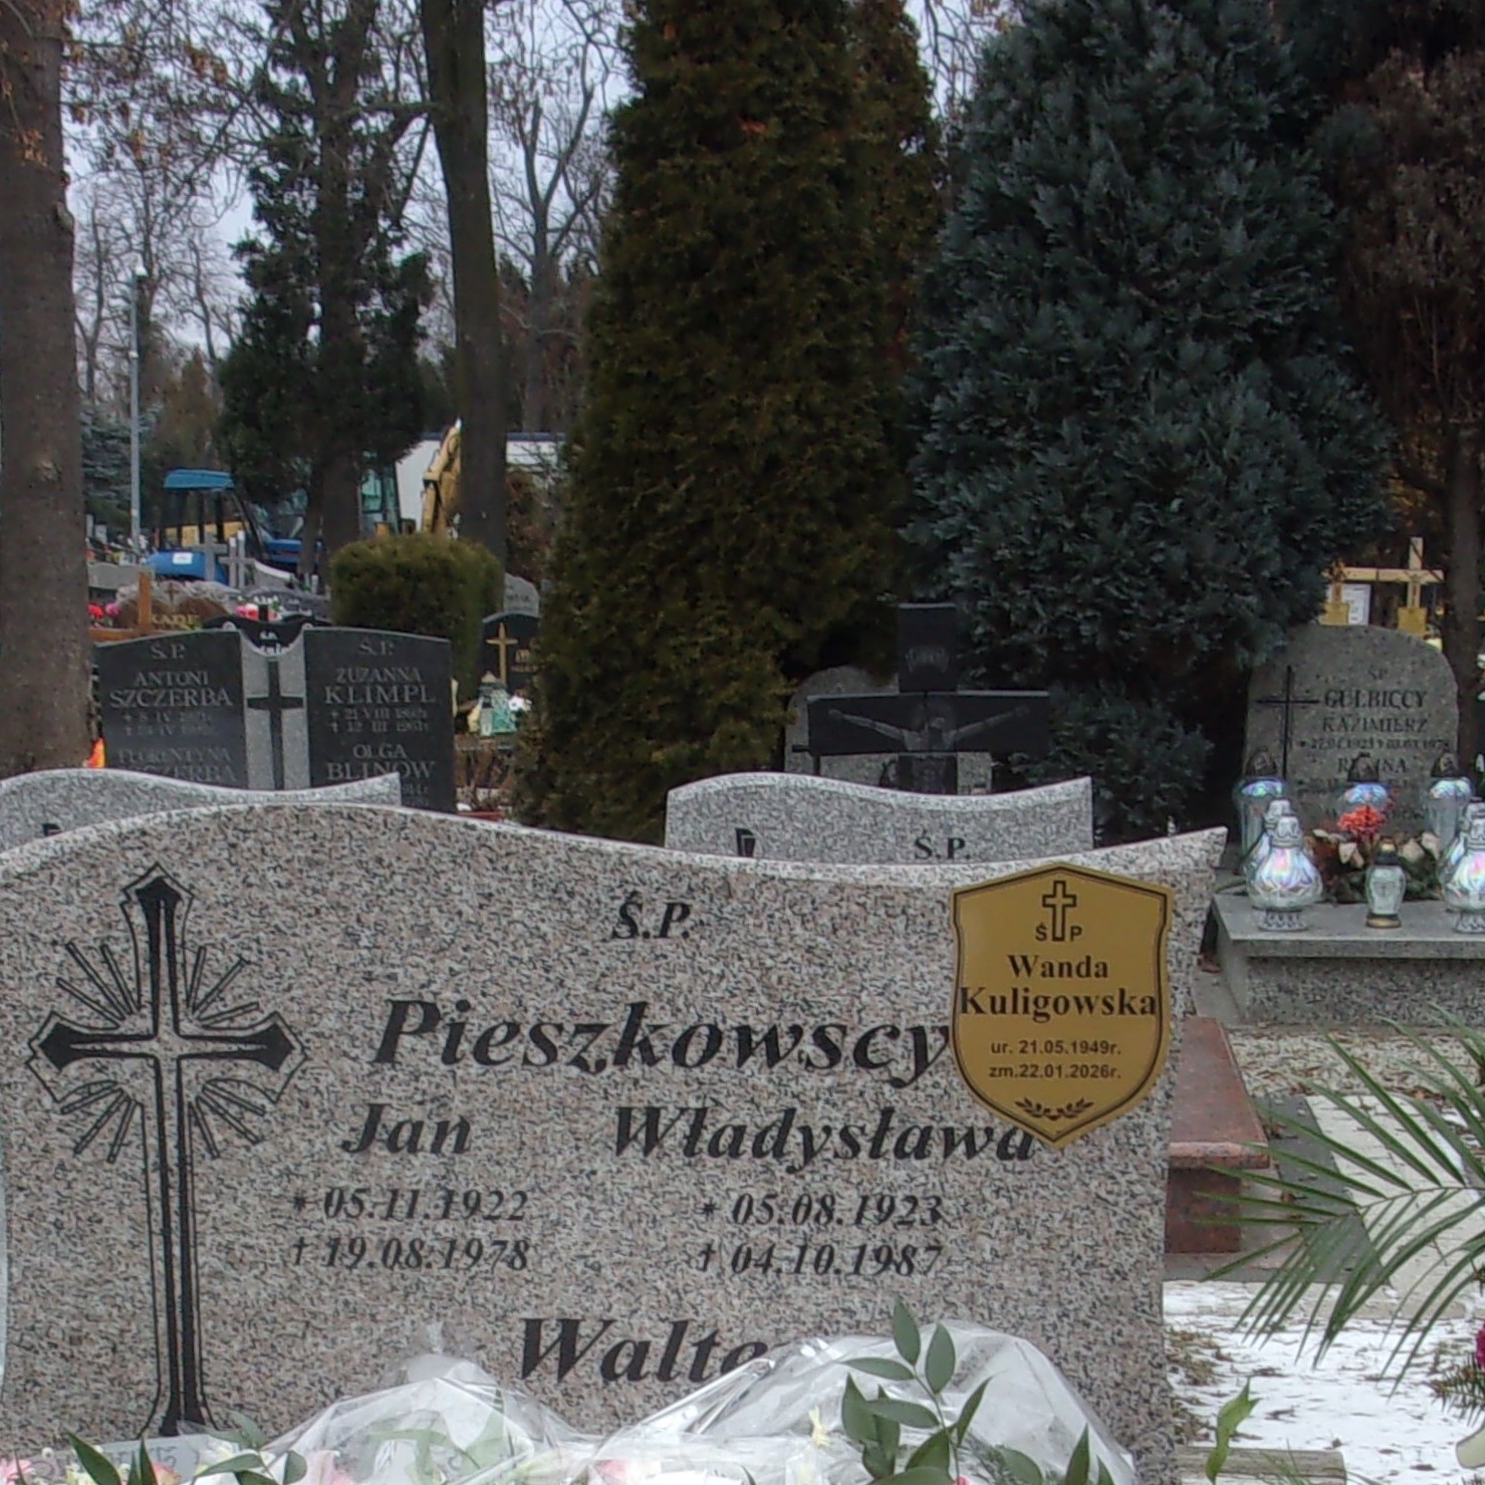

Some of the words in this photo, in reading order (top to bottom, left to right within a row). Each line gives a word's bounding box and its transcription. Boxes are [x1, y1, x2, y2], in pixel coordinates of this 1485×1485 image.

[134, 671, 209, 687] ANTONI
[335, 666, 423, 684] ZUZANNA
[109, 688, 233, 708] SZCZERBA
[324, 685, 436, 704] KLIMPL
[1323, 716, 1429, 733] KAZIMIERZ
[353, 742, 408, 760] OLGA
[916, 832, 972, 860] Ś.P.
[612, 891, 694, 941] Ś.P.
[1034, 922, 1048, 942] Ś
[1069, 926, 1083, 941] P
[1006, 954, 1109, 979] Wanda
[960, 986, 1157, 1024] Kuligowska
[376, 998, 953, 1090] Pieszkowscy
[990, 1042, 1013, 1055] ur.
[1018, 1040, 1122, 1055] 21.05.1949r.
[988, 1064, 1122, 1079] zm.22.01.2026r.
[341, 1102, 472, 1157] Jan
[613, 1104, 1039, 1173] Władysława
[321, 1188, 528, 1223] 05.11.1922
[729, 1192, 944, 1229] 05.08.1923
[323, 1237, 530, 1273] 19.08.1978
[728, 1241, 942, 1277] 04.10.1987
[519, 1317, 769, 1384] Walte
